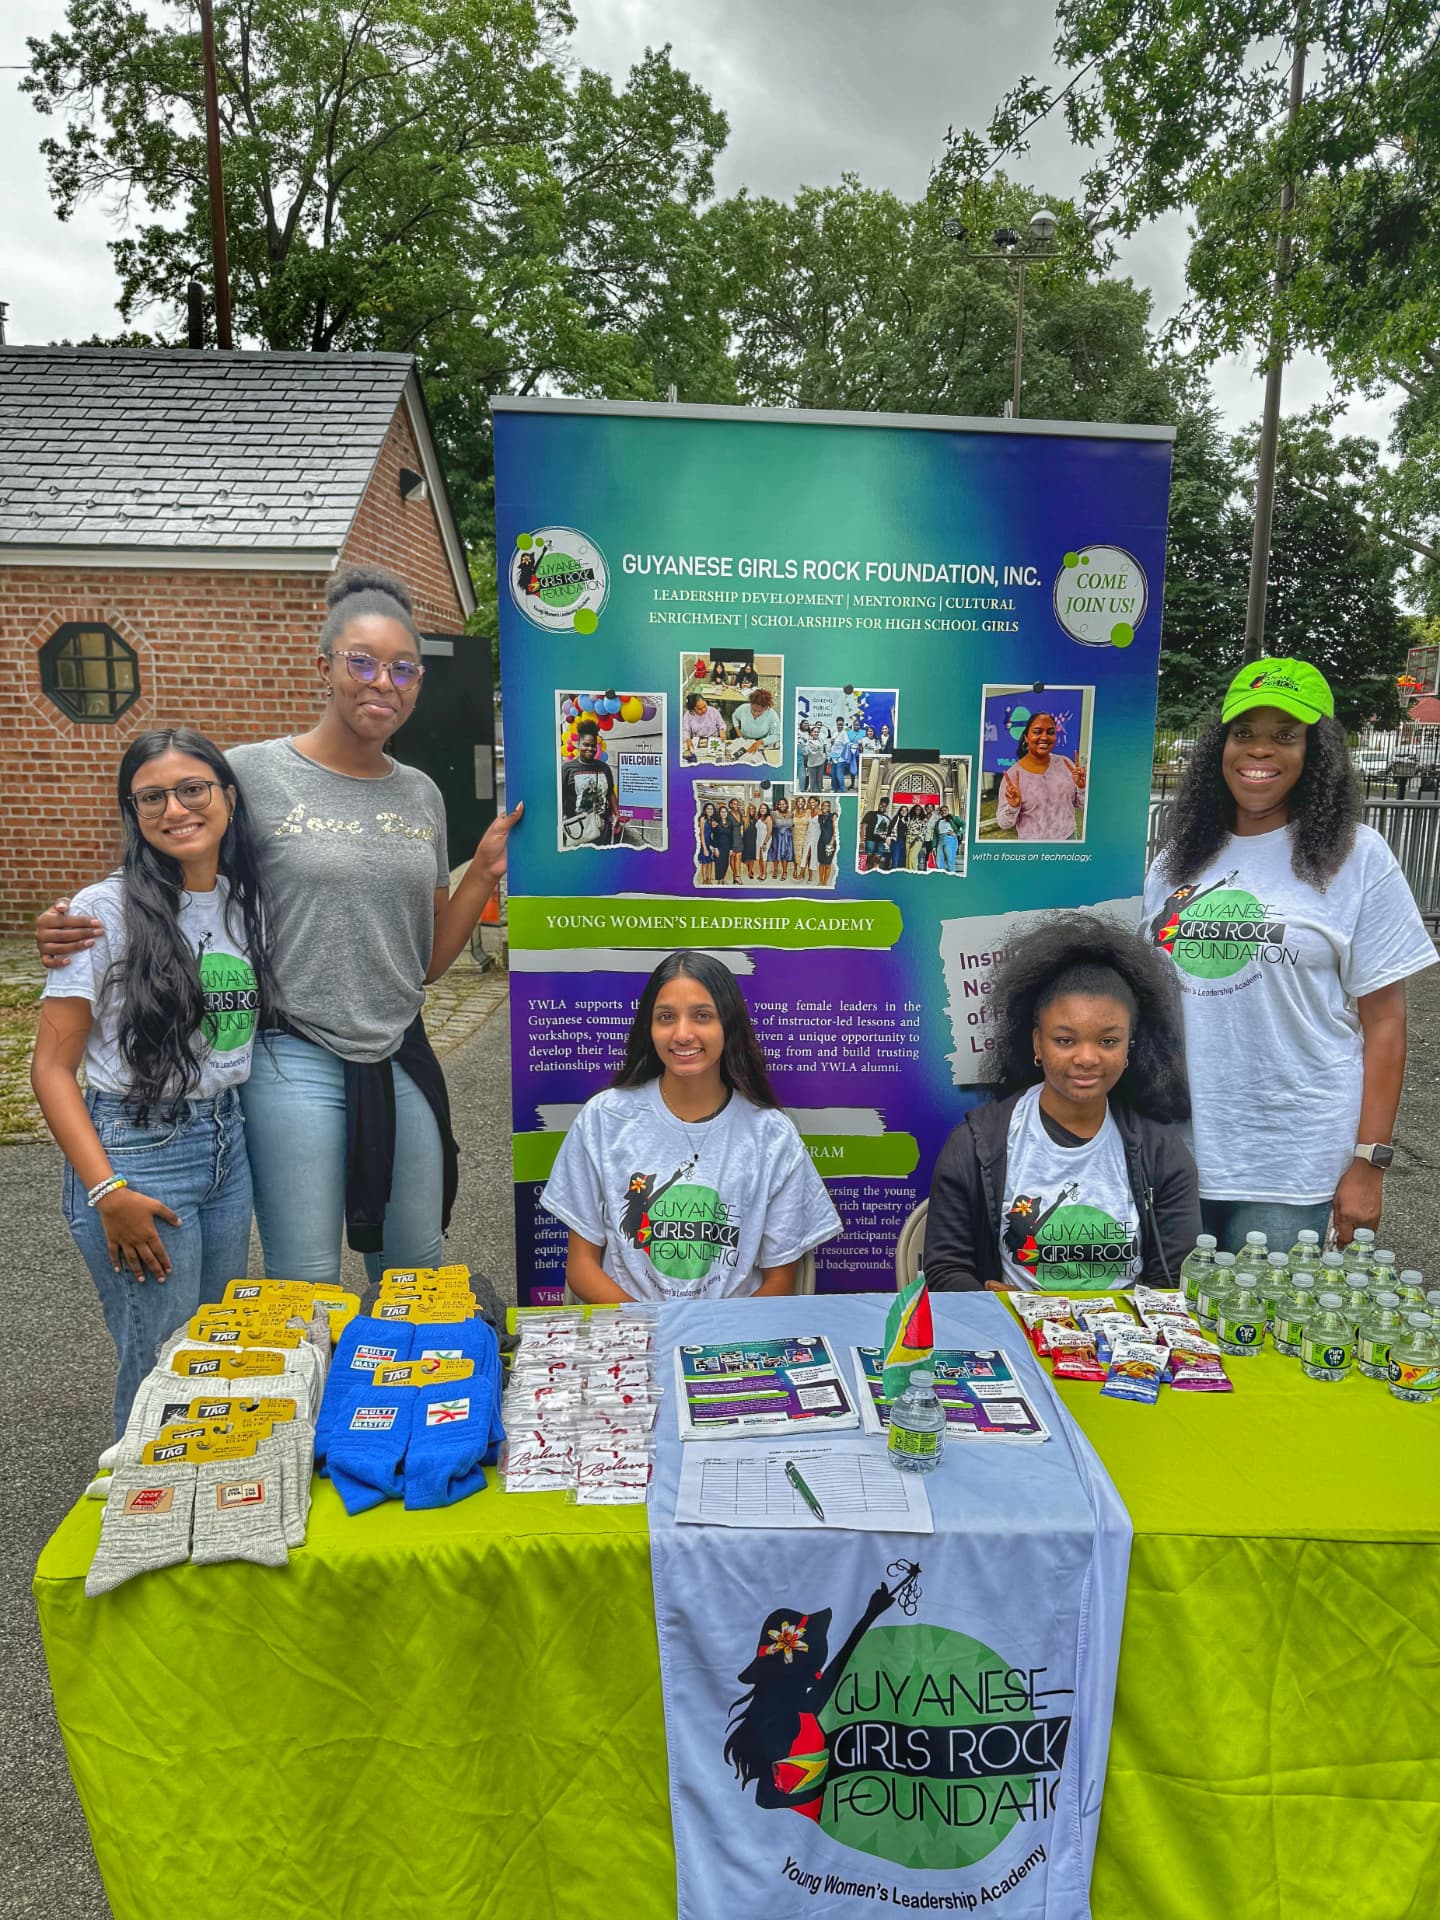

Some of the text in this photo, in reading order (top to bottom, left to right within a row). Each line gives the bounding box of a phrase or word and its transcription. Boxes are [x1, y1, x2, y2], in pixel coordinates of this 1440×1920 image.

[622, 554, 1042, 588] GUYANESE GIRLS ROCK FOUNDATION, INC.
[540, 570, 590, 588] GIRLS ROCK
[1076, 572, 1128, 590] COME
[542, 580, 605, 600] FOUNDATION
[654, 589, 1016, 611] LEADERSHIP DEVELOPMENT MENTORING CULTURAL
[1065, 596, 1135, 615] JOIN US!
[649, 611, 1019, 633] ENRICHMENT SCHOLARSHIPS FOR HIGH SCHOOL GIRLS
[620, 755, 662, 766] WELCOME!
[972, 852, 992, 862] with
[1002, 852, 1025, 862] focus
[1041, 852, 1092, 864] technology.
[1187, 903, 1284, 919] GUYANESE
[546, 915, 875, 931] YOUNG WOMEN'S LEADERSHIP ACADEMY
[1180, 921, 1278, 943] GIRLS ROCK
[959, 950, 1004, 970] Insp
[1177, 941, 1299, 966] FOUNDATION
[963, 979, 992, 998] Ne
[1197, 986, 1234, 997] Leadership
[1234, 971, 1263, 992] Academy
[528, 999, 567, 1010] YWLA
[575, 1000, 623, 1012] supports
[754, 1000, 921, 1013] young female leaders in the
[528, 1015, 635, 1028] Guyanese commun
[762, 1014, 775, 1026] of
[778, 1015, 853, 1027] instructor-led
[857, 1015, 897, 1027] lessons
[900, 1016, 920, 1027] and
[967, 1006, 986, 1026] of
[529, 1030, 630, 1043] workshops, young
[755, 1031, 920, 1044] given a unique opportunity to
[529, 1046, 573, 1058] develop
[577, 1044, 603, 1055] their
[786, 1046, 812, 1057] from
[817, 1047, 838, 1057] and
[843, 1046, 871, 1058] build
[877, 1047, 920, 1059] trusting
[529, 1060, 626, 1073] relationships with
[765, 1061, 902, 1073] ntors and YWLA alumni.
[829, 1185, 916, 1199] ersing the young
[840, 1200, 917, 1213] rich tapestry of
[534, 1215, 557, 1225] their
[855, 1216, 877, 1226] vital
[881, 1216, 900, 1225] role
[534, 1229, 568, 1240] offerin
[653, 1222, 741, 1248] GIRLS ROCK
[837, 1231, 899, 1243] participants.
[1042, 1221, 1137, 1242] GUYANESE
[534, 1245, 568, 1257] equips
[822, 1246, 869, 1255] resources
[872, 1246, 882, 1255] to
[1041, 1243, 1134, 1262] GIRLS ROC
[535, 1258, 559, 1269] their
[826, 1259, 894, 1272] backgrounds.
[392, 1274, 416, 1283] TAG
[235, 1287, 261, 1298] TAG
[537, 1291, 564, 1303] Visit
[382, 1306, 410, 1317] TAG
[211, 1332, 239, 1342] TAG
[359, 1347, 392, 1356] MULTI
[191, 1360, 219, 1374] TAG
[353, 1359, 378, 1370] MAST
[384, 1368, 412, 1382] TAG
[201, 1405, 231, 1417] TAG
[358, 1408, 393, 1416] MULTI
[352, 1420, 391, 1429] MASTER
[155, 1445, 187, 1460] TAG
[580, 1457, 648, 1478] Believe
[835, 1667, 1074, 1717] GUYANESE
[835, 1719, 1067, 1775] GIRLS ROCK
[833, 1775, 1060, 1827] FOUNDATI
[781, 1843, 1048, 1912] Young Women's Leadership Academy
